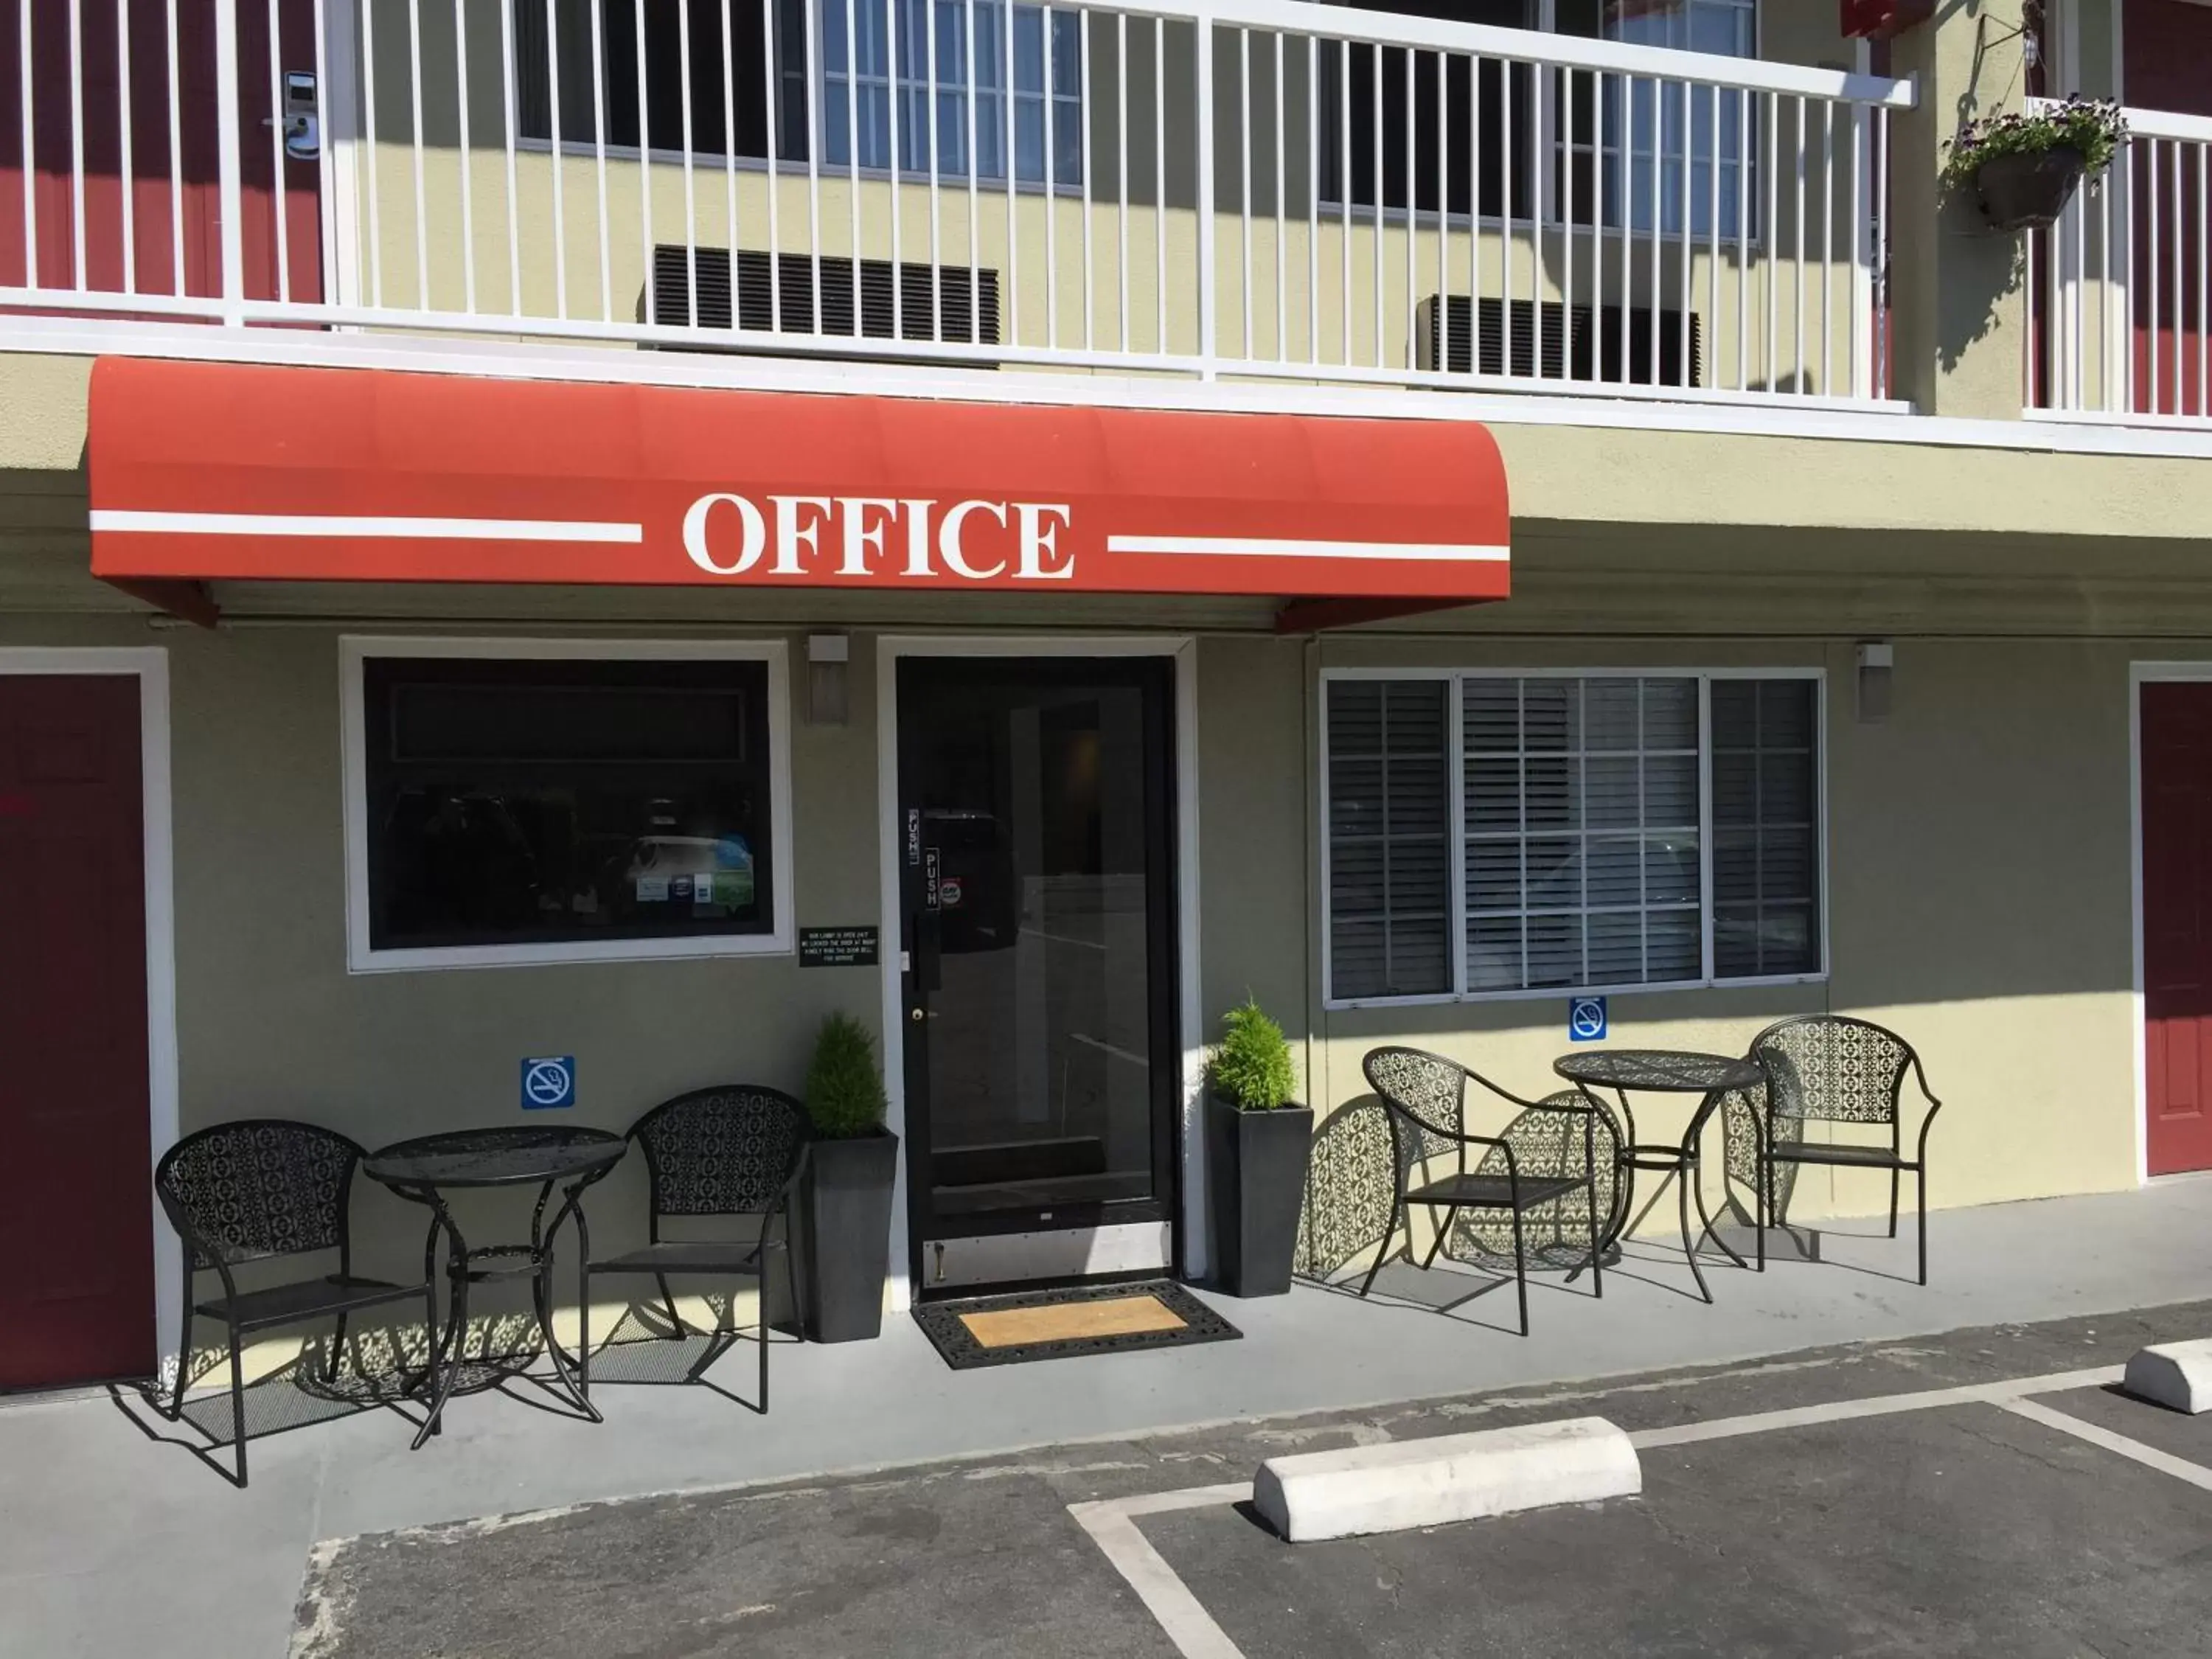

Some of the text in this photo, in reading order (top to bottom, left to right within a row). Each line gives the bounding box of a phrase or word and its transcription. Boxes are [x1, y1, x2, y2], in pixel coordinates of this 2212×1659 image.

[683, 493, 1074, 579] OFFICE
[908, 814, 917, 851] PUSH
[927, 854, 937, 905] PUSH
